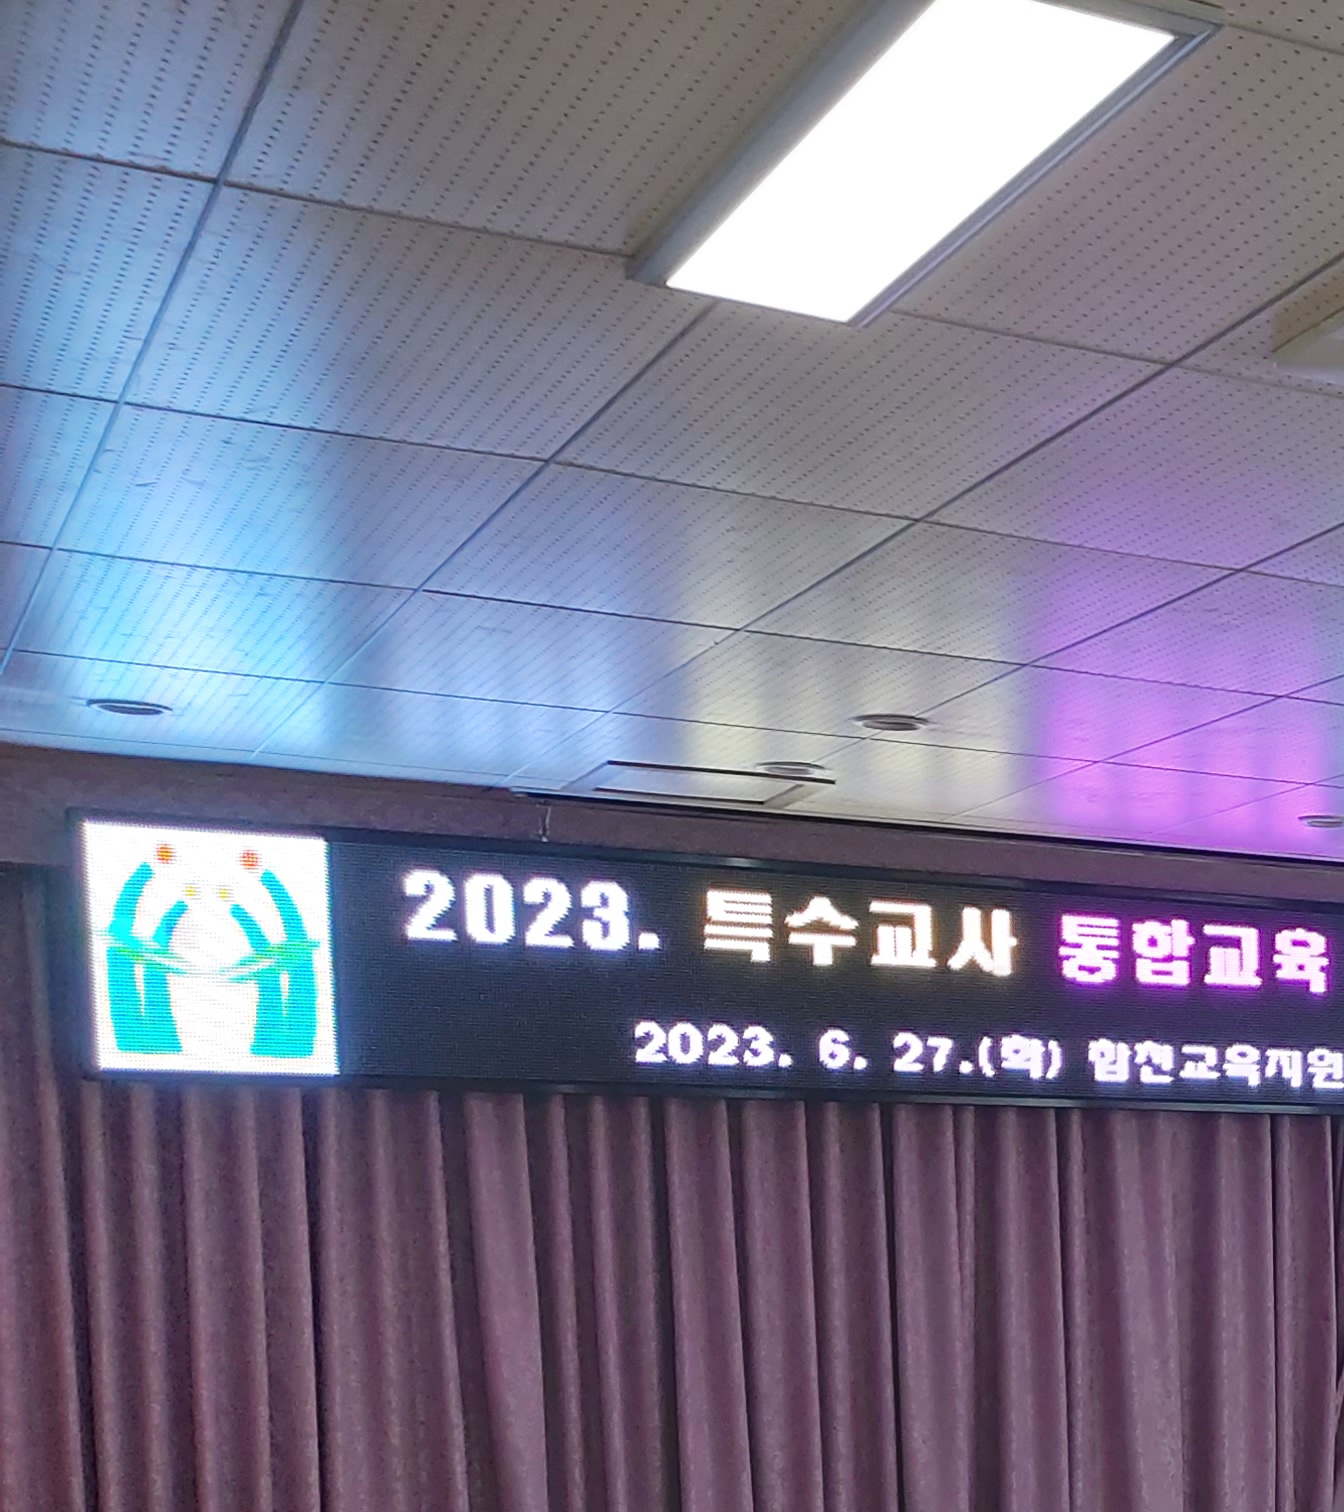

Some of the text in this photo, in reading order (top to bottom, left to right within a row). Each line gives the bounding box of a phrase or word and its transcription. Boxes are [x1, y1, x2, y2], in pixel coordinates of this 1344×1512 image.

[402, 868, 661, 952] 2023.
[703, 888, 1018, 977] 특수교사
[1057, 913, 1332, 995] 통합교육
[634, 1020, 793, 1069] 2023.
[818, 1029, 869, 1070] 6.
